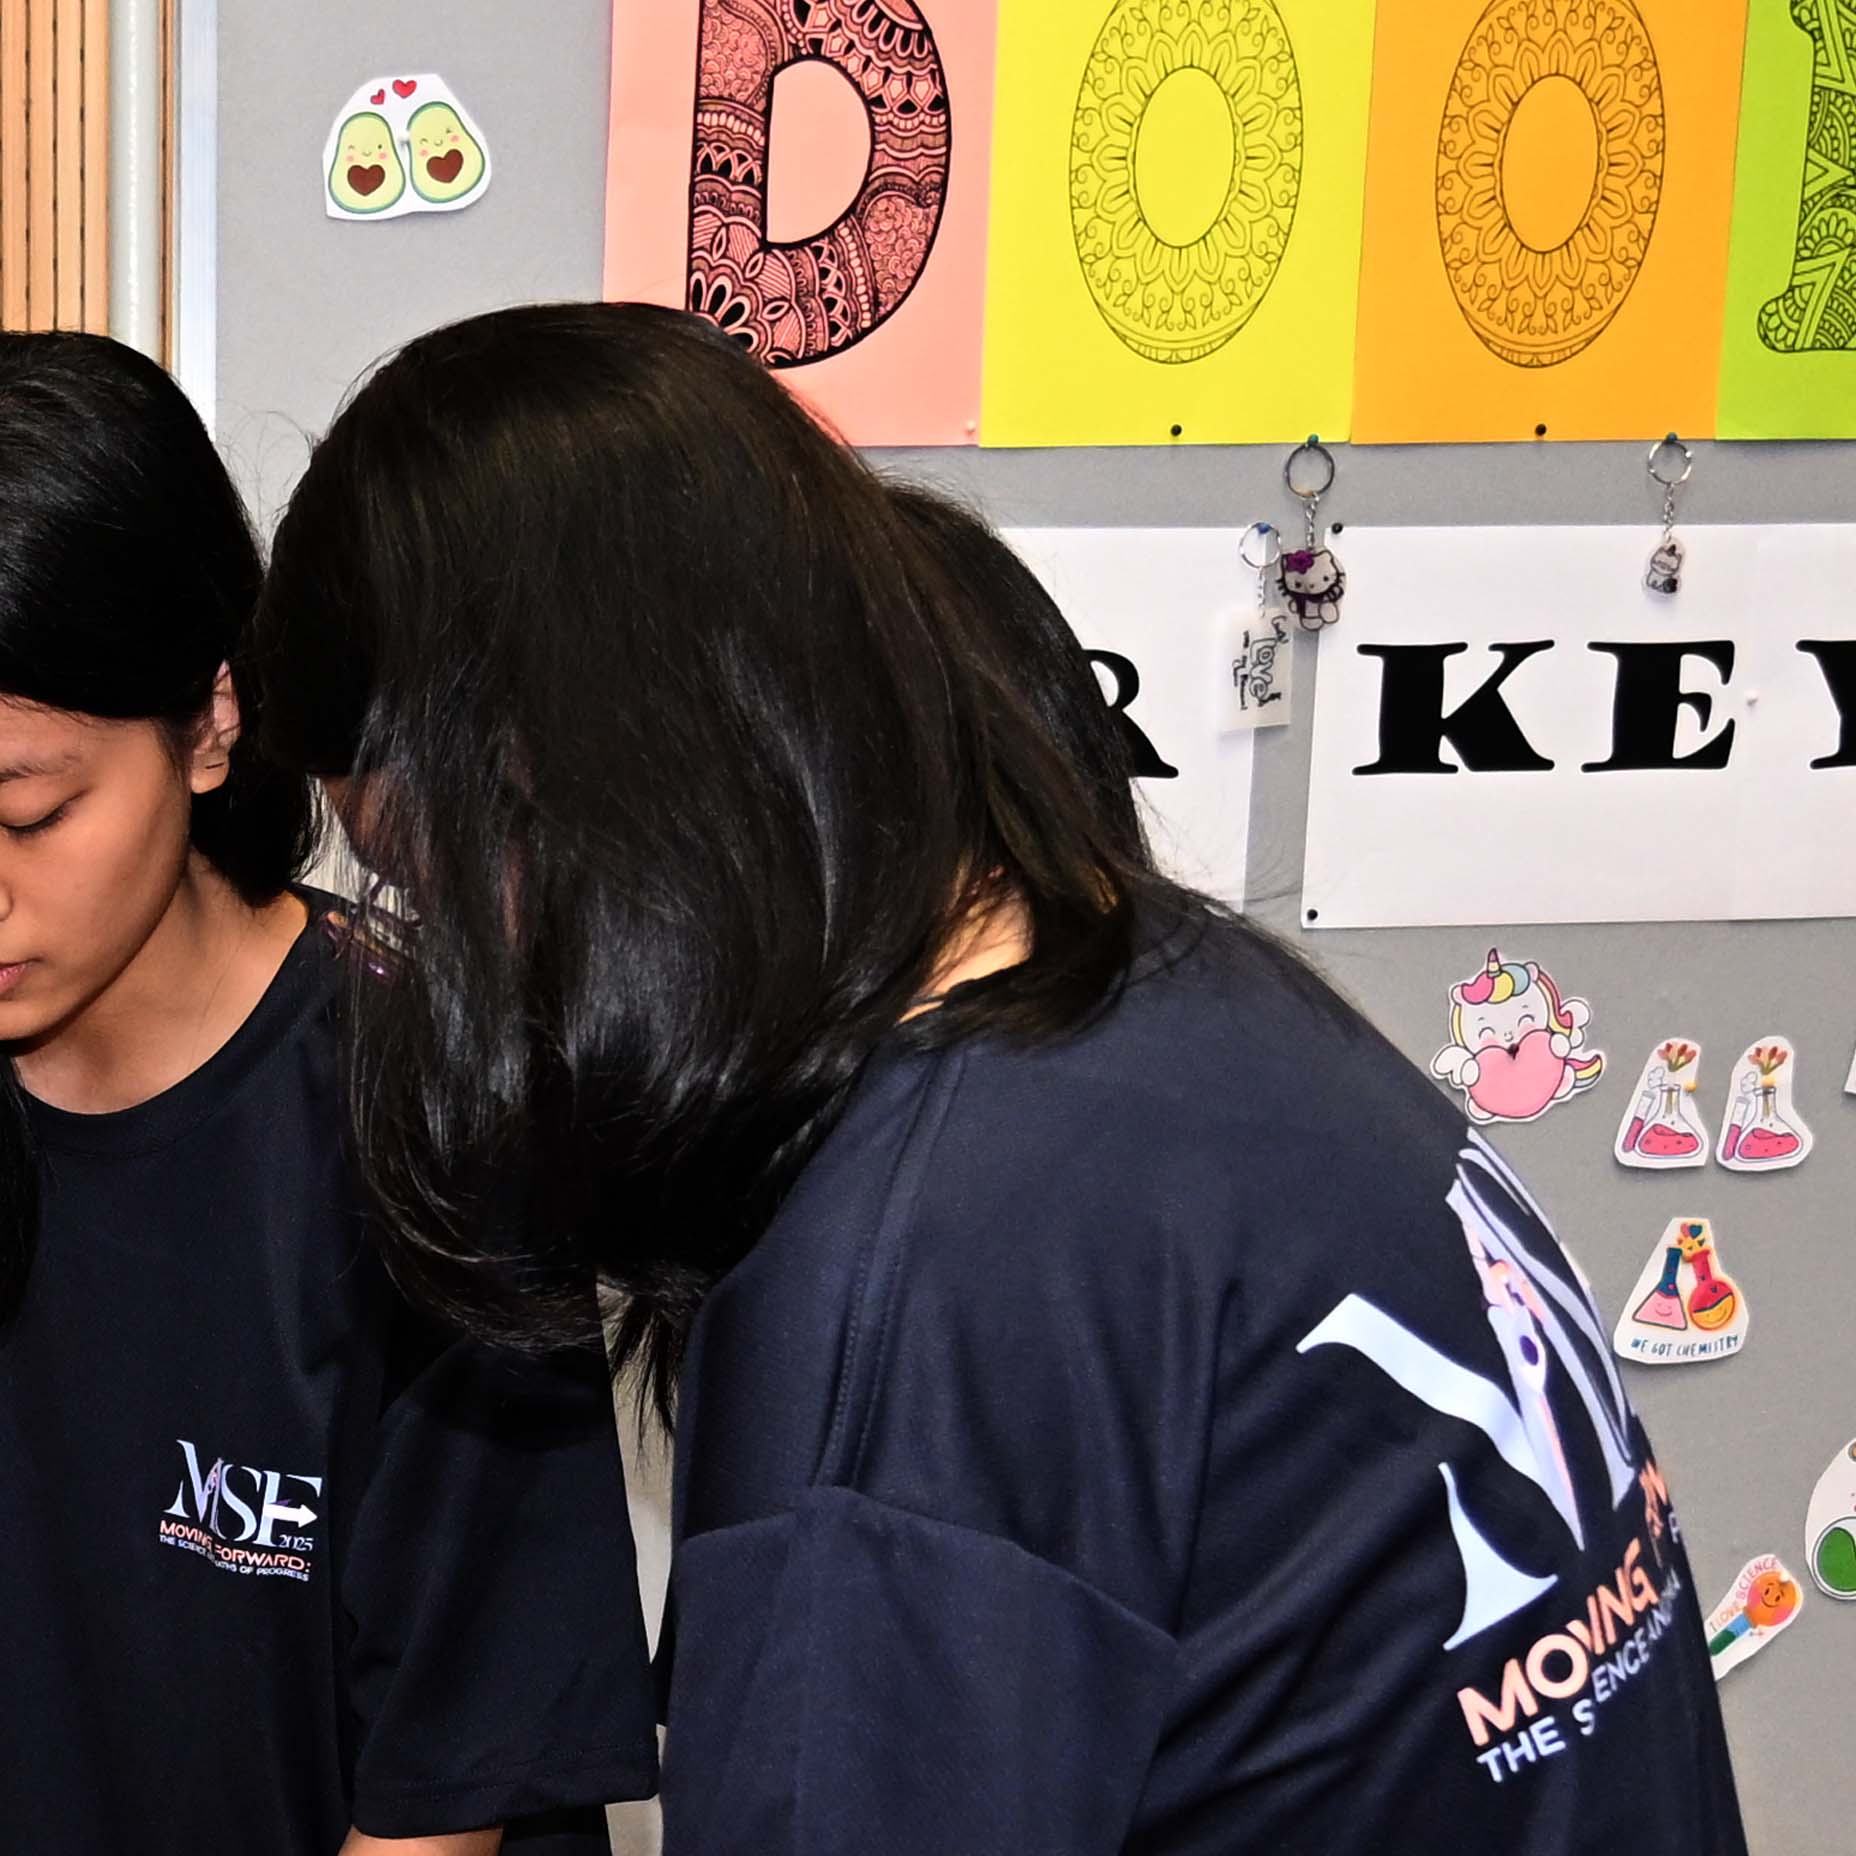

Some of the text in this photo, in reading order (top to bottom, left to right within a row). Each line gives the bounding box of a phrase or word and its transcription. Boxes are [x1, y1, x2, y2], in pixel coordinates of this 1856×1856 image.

[1651, 1342, 1673, 1358] GOT
[1676, 1334, 1740, 1358] CHEMISTRY
[1734, 1556, 1779, 1603] SCIENCE
[1475, 1714, 1567, 1784] THE
